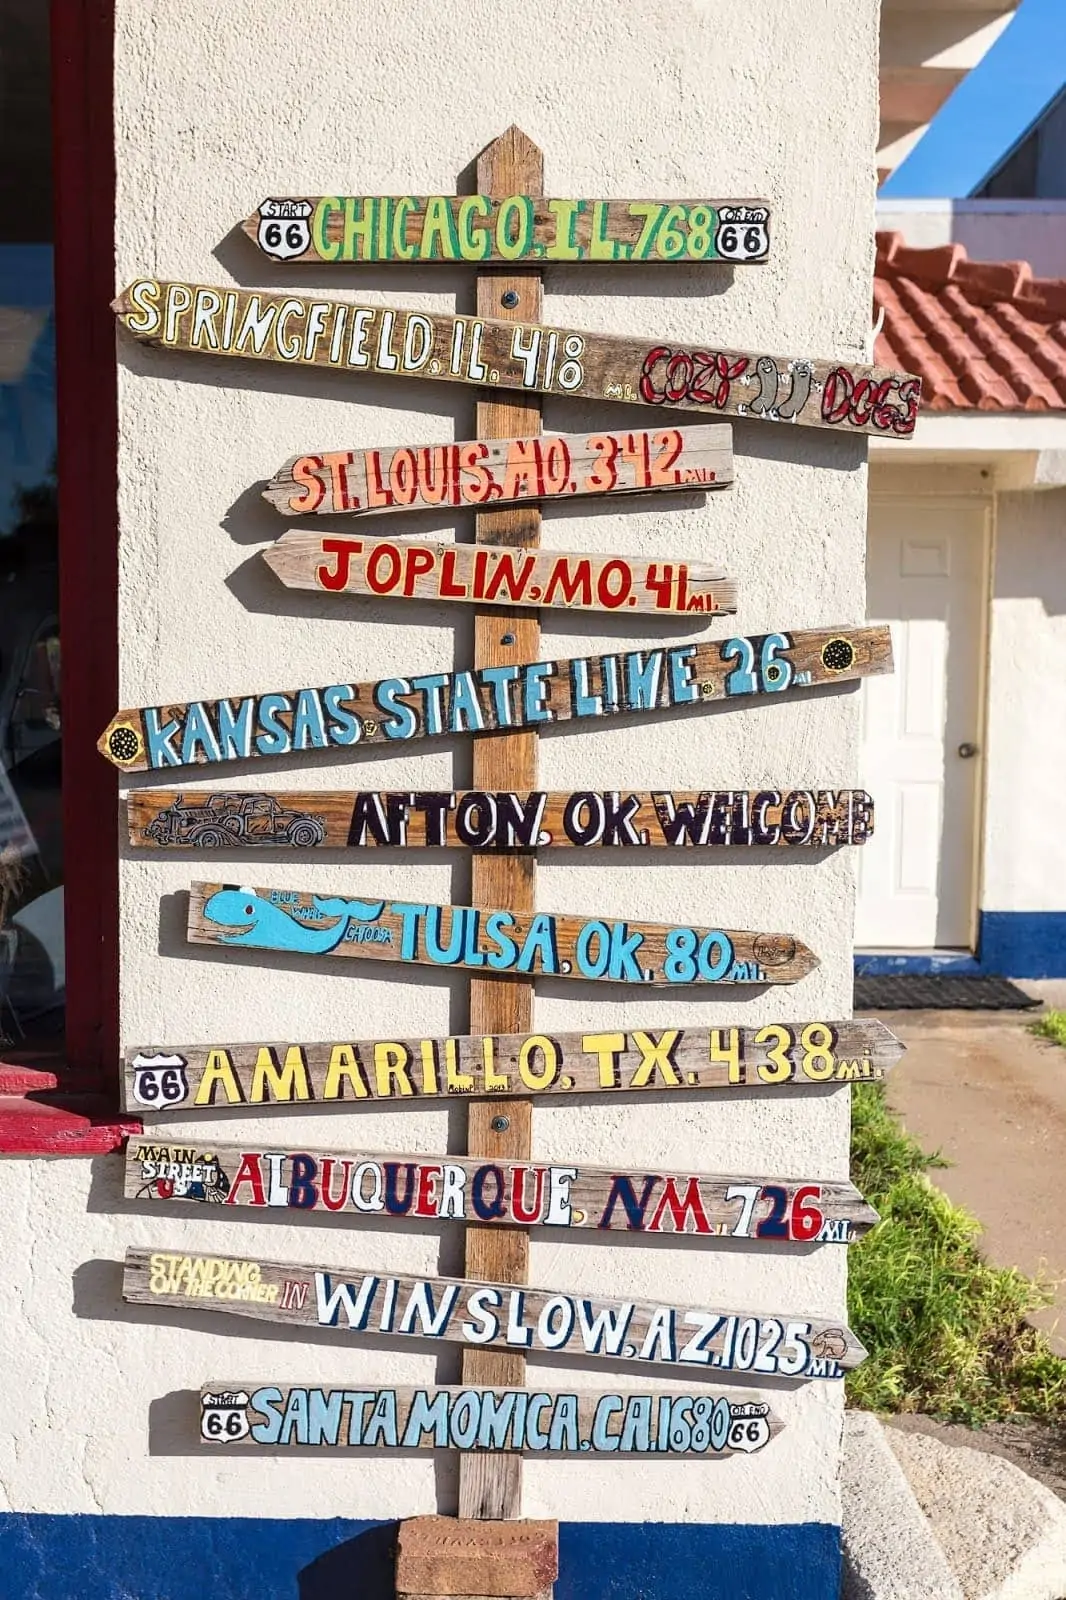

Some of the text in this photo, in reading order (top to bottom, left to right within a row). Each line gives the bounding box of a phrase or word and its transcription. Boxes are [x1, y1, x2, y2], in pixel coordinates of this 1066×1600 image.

[266, 203, 308, 217] START
[628, 204, 717, 259] 768
[265, 223, 303, 249] 66
[720, 226, 762, 252] 66
[510, 326, 585, 391] 418
[639, 346, 749, 409] COZY
[821, 367, 922, 434] DOGS
[584, 430, 683, 492] 342
[645, 563, 689, 612] 41
[373, 661, 558, 741] STATE
[569, 644, 700, 718] LINE
[719, 632, 796, 697] 26
[651, 790, 875, 846] WELCOME
[664, 928, 735, 982] 80
[709, 1022, 839, 1085] 438
[139, 1070, 181, 1101] 66
[134, 1145, 196, 1163] MAIN
[142, 1161, 216, 1183] STREET
[724, 1185, 825, 1241] 726
[150, 1275, 278, 1302] ON THE CORNER
[151, 1254, 261, 1283] STANDING
[279, 1280, 310, 1310] IN
[720, 1316, 812, 1377] 1025
[207, 1412, 242, 1435] 66
[250, 1387, 400, 1446] SANTA
[656, 1395, 731, 1452] 1680
[731, 1421, 760, 1443] 66
